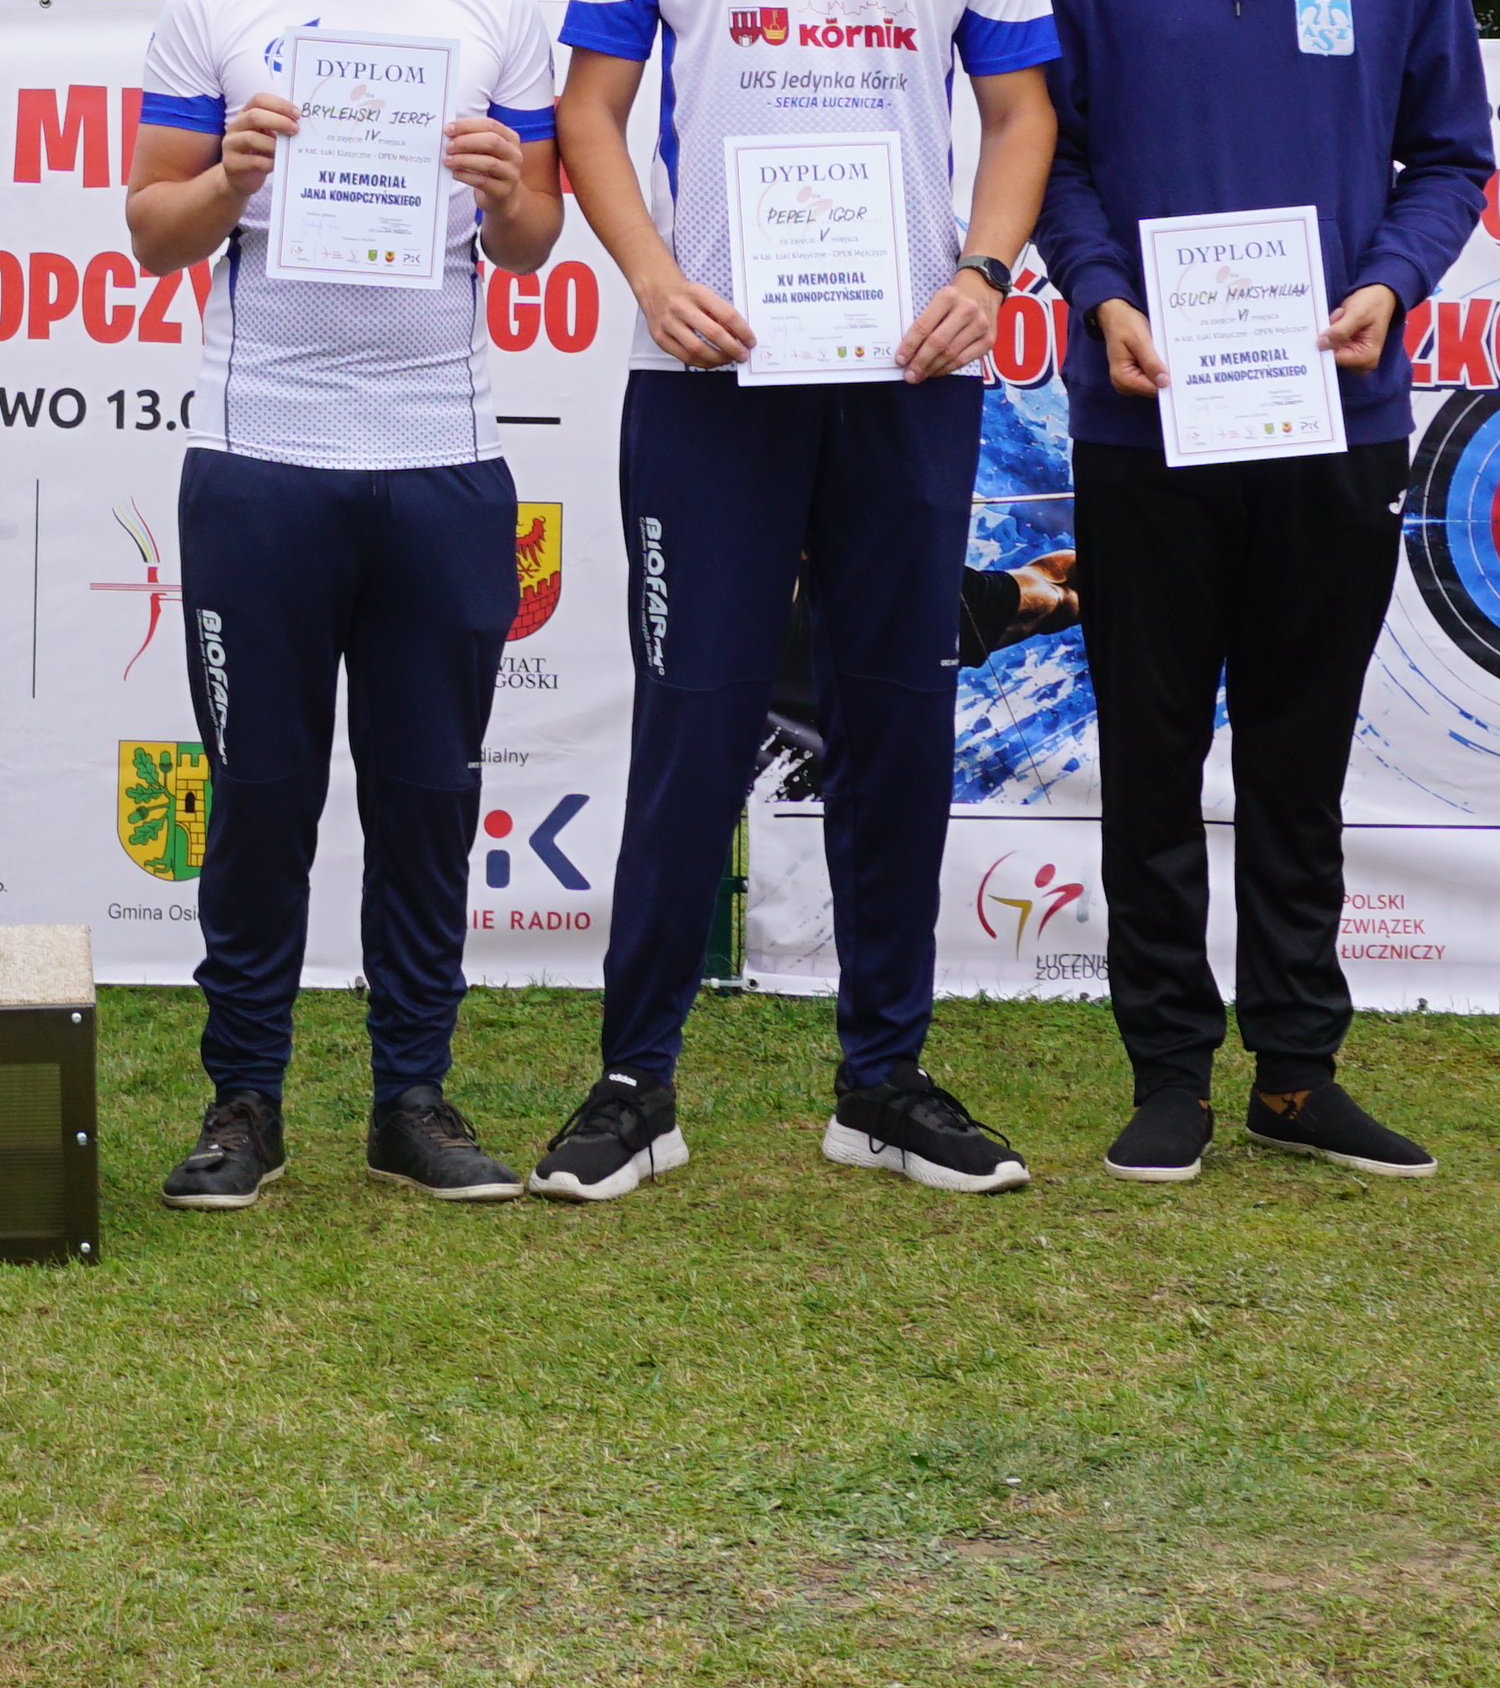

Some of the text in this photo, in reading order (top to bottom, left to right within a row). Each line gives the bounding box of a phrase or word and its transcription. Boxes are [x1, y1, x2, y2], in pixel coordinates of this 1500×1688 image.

[316, 59, 426, 84] DYPLOM
[740, 70, 777, 89] UKS
[782, 70, 855, 93] Jedynka
[774, 97, 884, 109] SEKCJA ŁUCZNICZA
[389, 111, 436, 127] JERZY
[364, 129, 381, 141] IV
[319, 170, 407, 189] XV MEMORIAŁ
[760, 163, 869, 184] DYPLOM
[300, 188, 422, 208] JANA KONOPCZYŃSKIEGO
[767, 206, 867, 224] PEPEL IGOR
[1177, 239, 1287, 265] DYPLOM
[777, 272, 866, 287] XV MEMORIAŁ
[762, 287, 884, 304] JANA KONOPCZYŃSKIEGO
[1169, 283, 1310, 308] OSUCH MAKSYMILIAN
[1199, 348, 1290, 367] XV MEMORIAŁ
[1186, 365, 1308, 385] JANA KONOPCZYŃSKIEGO
[1342, 894, 1405, 910] POLSKI
[108, 903, 162, 921] Gmina
[510, 912, 591, 931] RADIO
[1341, 919, 1426, 939] ZWIĄZEK
[1341, 944, 1446, 960] ŁUCZNICZY
